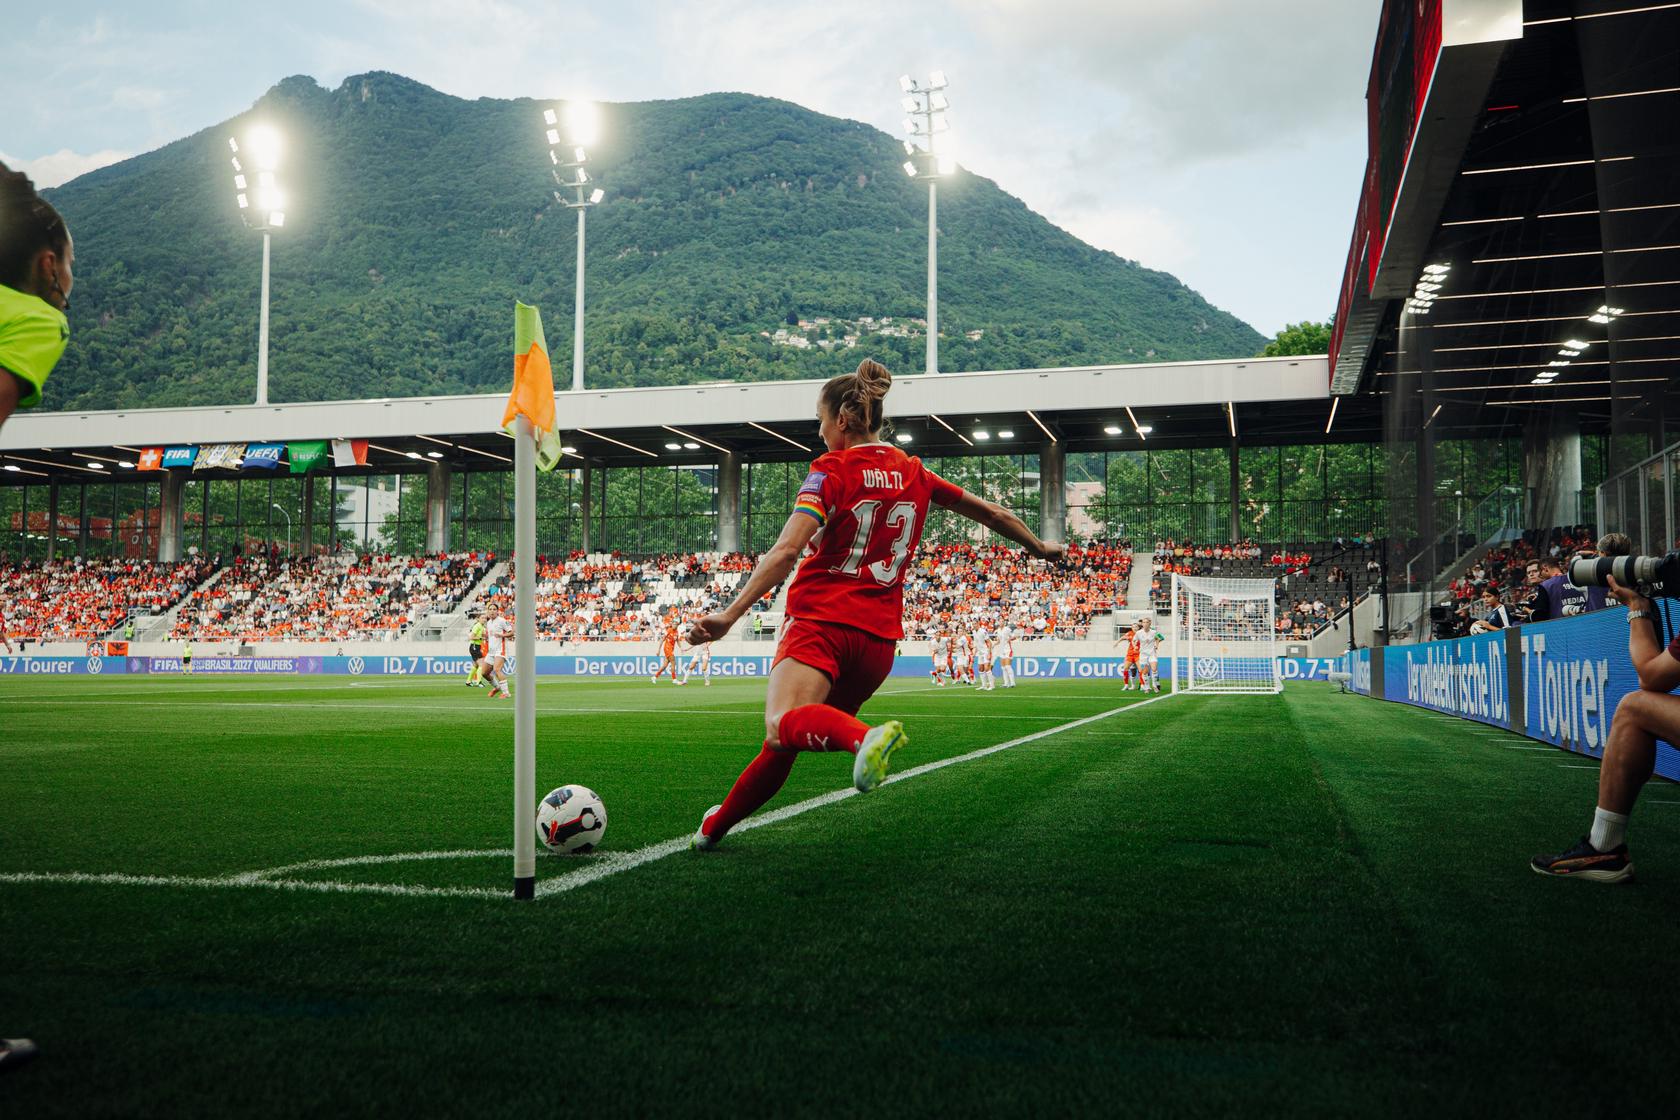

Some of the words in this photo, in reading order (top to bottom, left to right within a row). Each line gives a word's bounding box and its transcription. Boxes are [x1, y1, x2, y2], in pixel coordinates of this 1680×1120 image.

[166, 449, 190, 460] FIFA
[246, 448, 279, 460] UEFA
[862, 468, 904, 490] WÄLTI
[828, 500, 917, 588] 13
[1561, 596, 1586, 606] MEDIA
[22, 657, 74, 673] Tourer
[154, 660, 179, 671] FIFA
[205, 659, 232, 671] BRASIL
[233, 659, 252, 671] 2027
[253, 659, 293, 672] QUALIFIERS
[383, 656, 419, 674] ID.7
[423, 656, 473, 674] Toure
[575, 657, 607, 675] Der
[1016, 658, 1061, 677] ID.7
[1407, 651, 1419, 702] Der
[1532, 633, 1608, 749] Tourer
